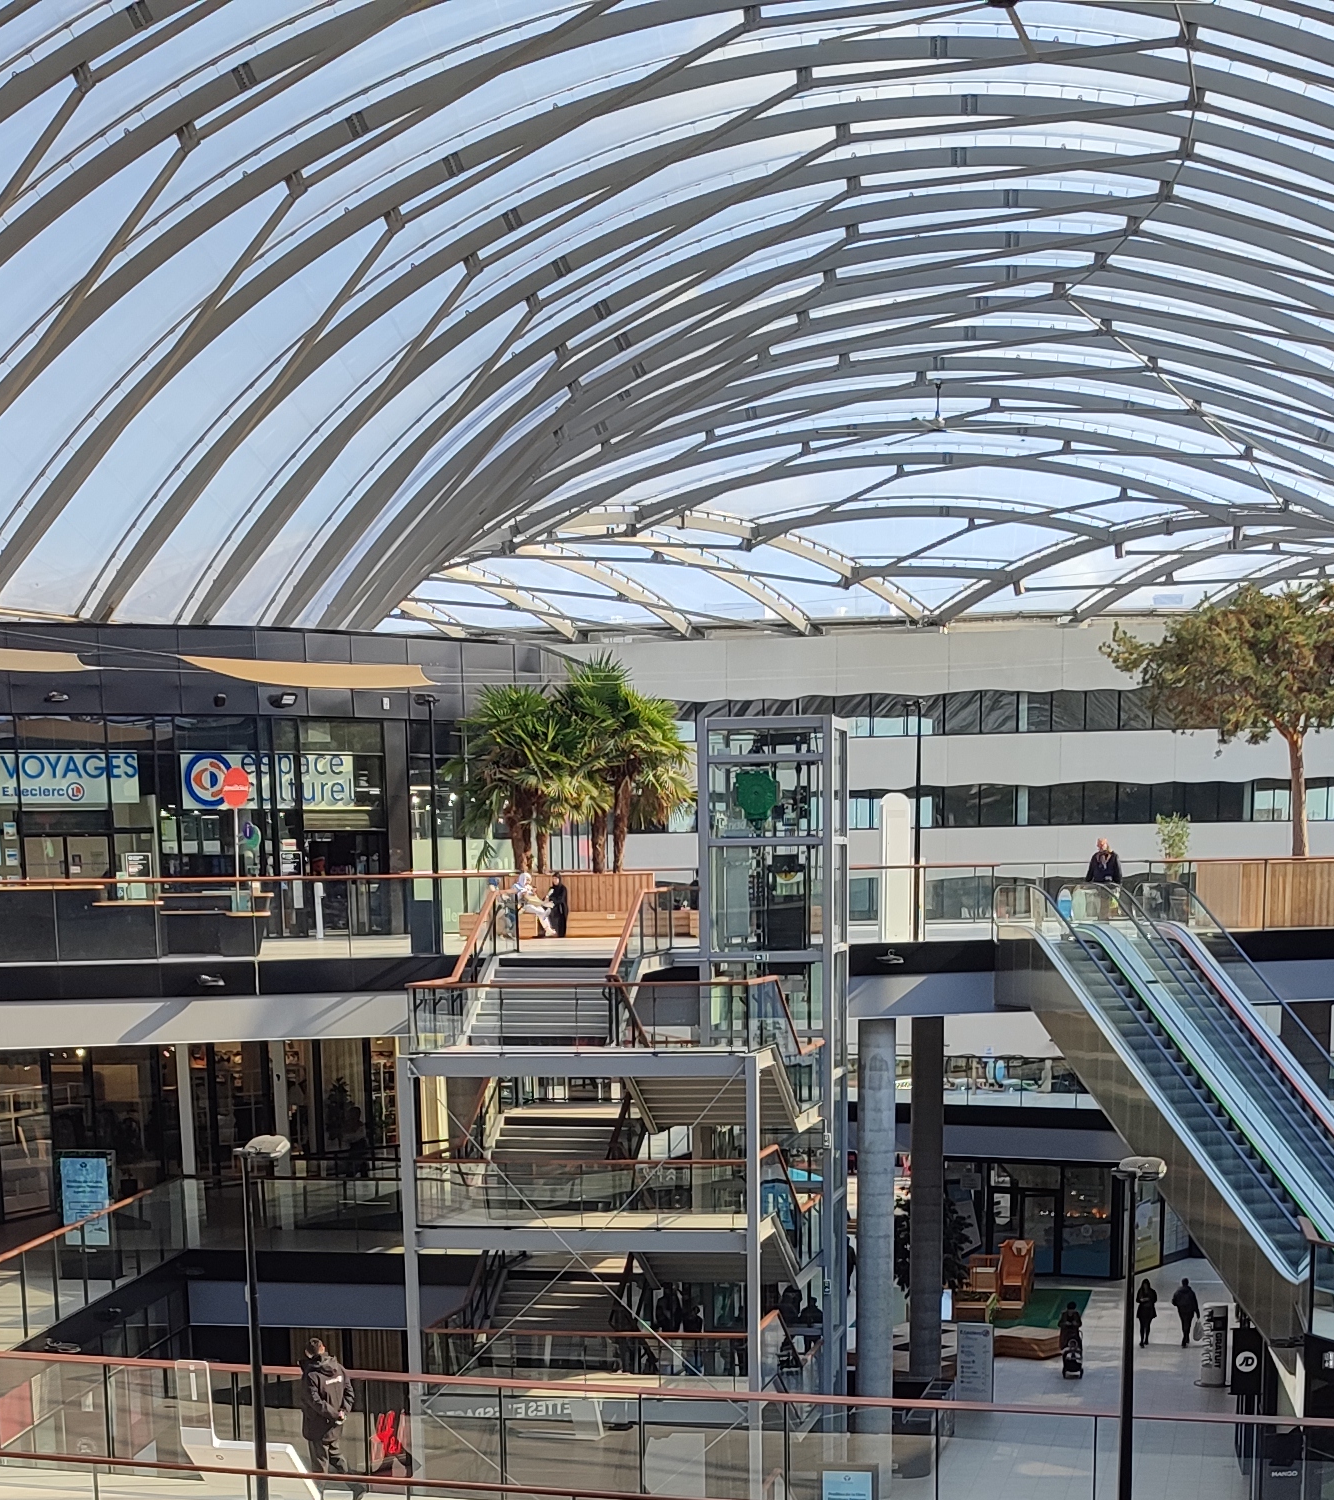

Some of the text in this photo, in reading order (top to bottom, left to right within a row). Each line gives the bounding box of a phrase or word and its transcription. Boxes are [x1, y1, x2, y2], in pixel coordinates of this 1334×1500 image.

[0, 754, 138, 779] VOYAGES
[241, 754, 344, 775] espace
[1214, 1332, 1223, 1369] GRATUIT
